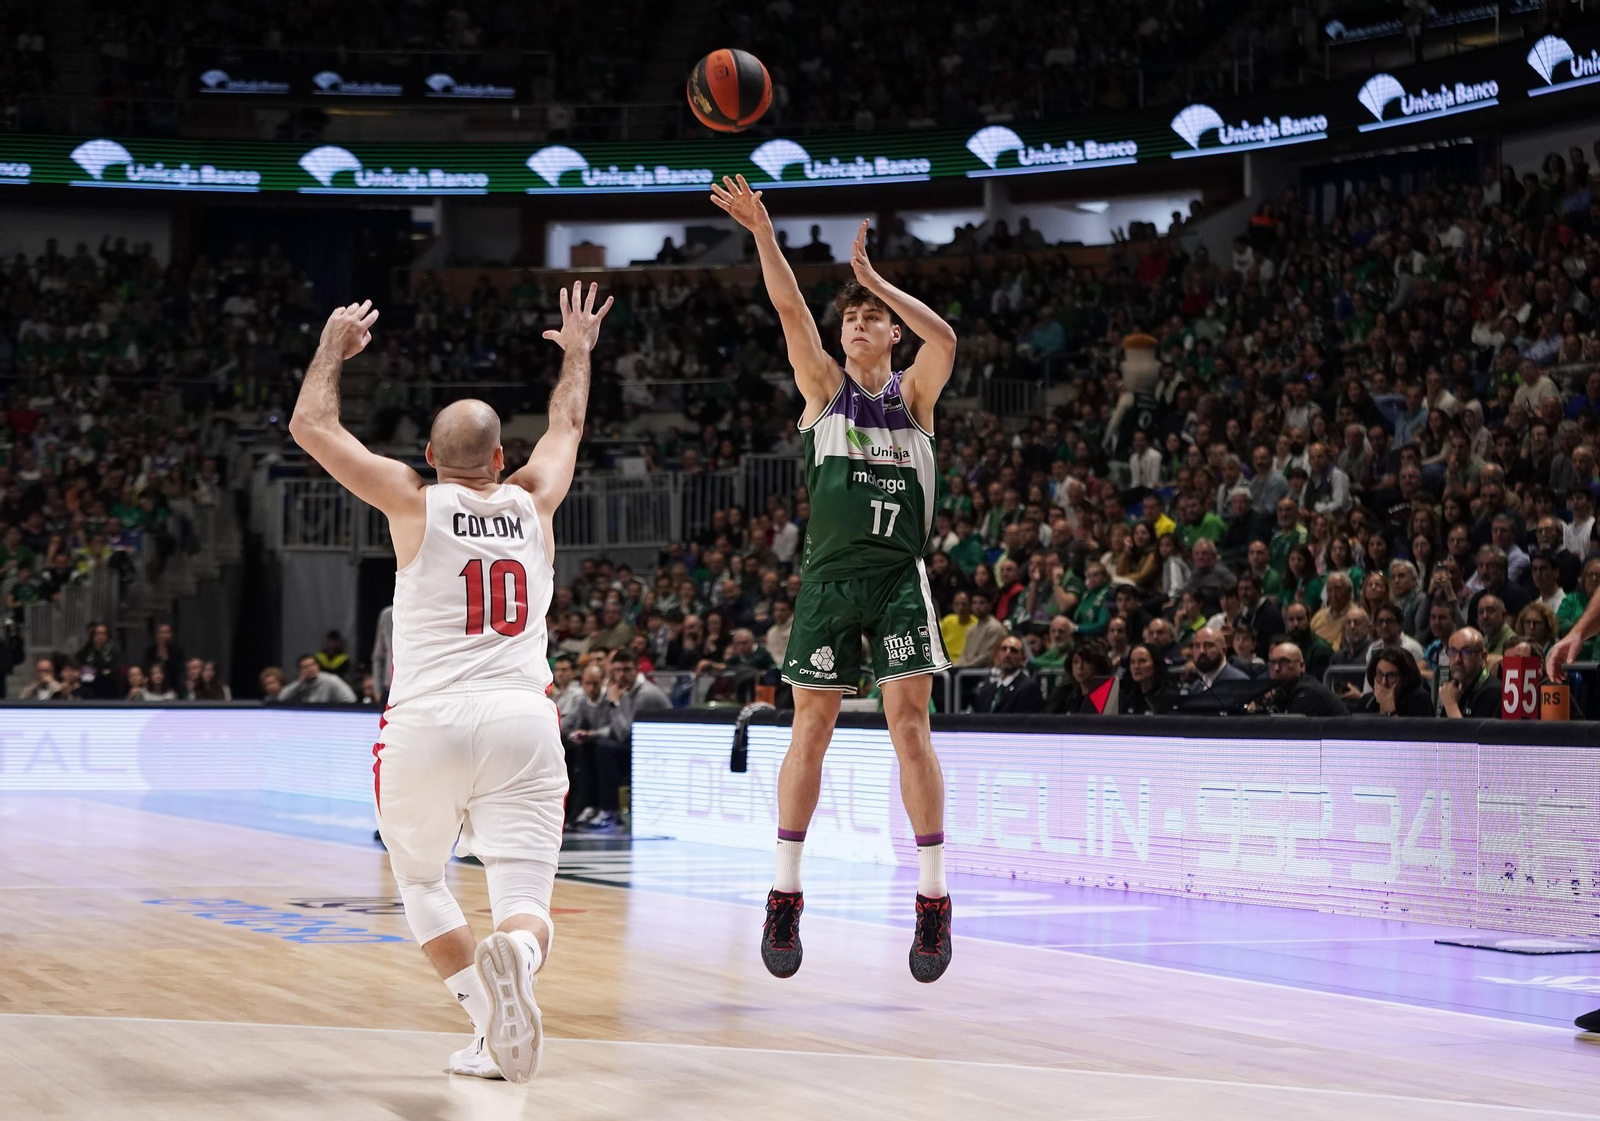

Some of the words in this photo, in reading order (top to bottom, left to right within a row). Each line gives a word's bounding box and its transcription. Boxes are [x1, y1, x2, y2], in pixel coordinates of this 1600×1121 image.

[1401, 83, 1455, 113] Unicaja
[1454, 79, 1499, 101] Banco
[1218, 116, 1280, 144] Unicaja
[1280, 114, 1328, 137] Banco
[1017, 140, 1084, 166] Unicaja
[1084, 139, 1138, 160] Banco
[126, 162, 200, 188] Unicaja
[201, 165, 261, 185] Banco
[354, 167, 429, 192] Unicaja
[429, 169, 489, 188] Banco
[581, 164, 654, 189] Unicaja
[654, 165, 714, 185] Banco
[804, 156, 874, 181] Unicaja
[874, 156, 931, 176] Banco
[871, 445, 910, 461] Uniaja
[453, 512, 524, 540] COLOM
[870, 500, 900, 538] 17
[458, 558, 528, 637] 10
[686, 754, 881, 834] DENAL
[1198, 780, 1333, 877] 952
[1350, 785, 1456, 885] 34
[141, 898, 413, 944] endesa
